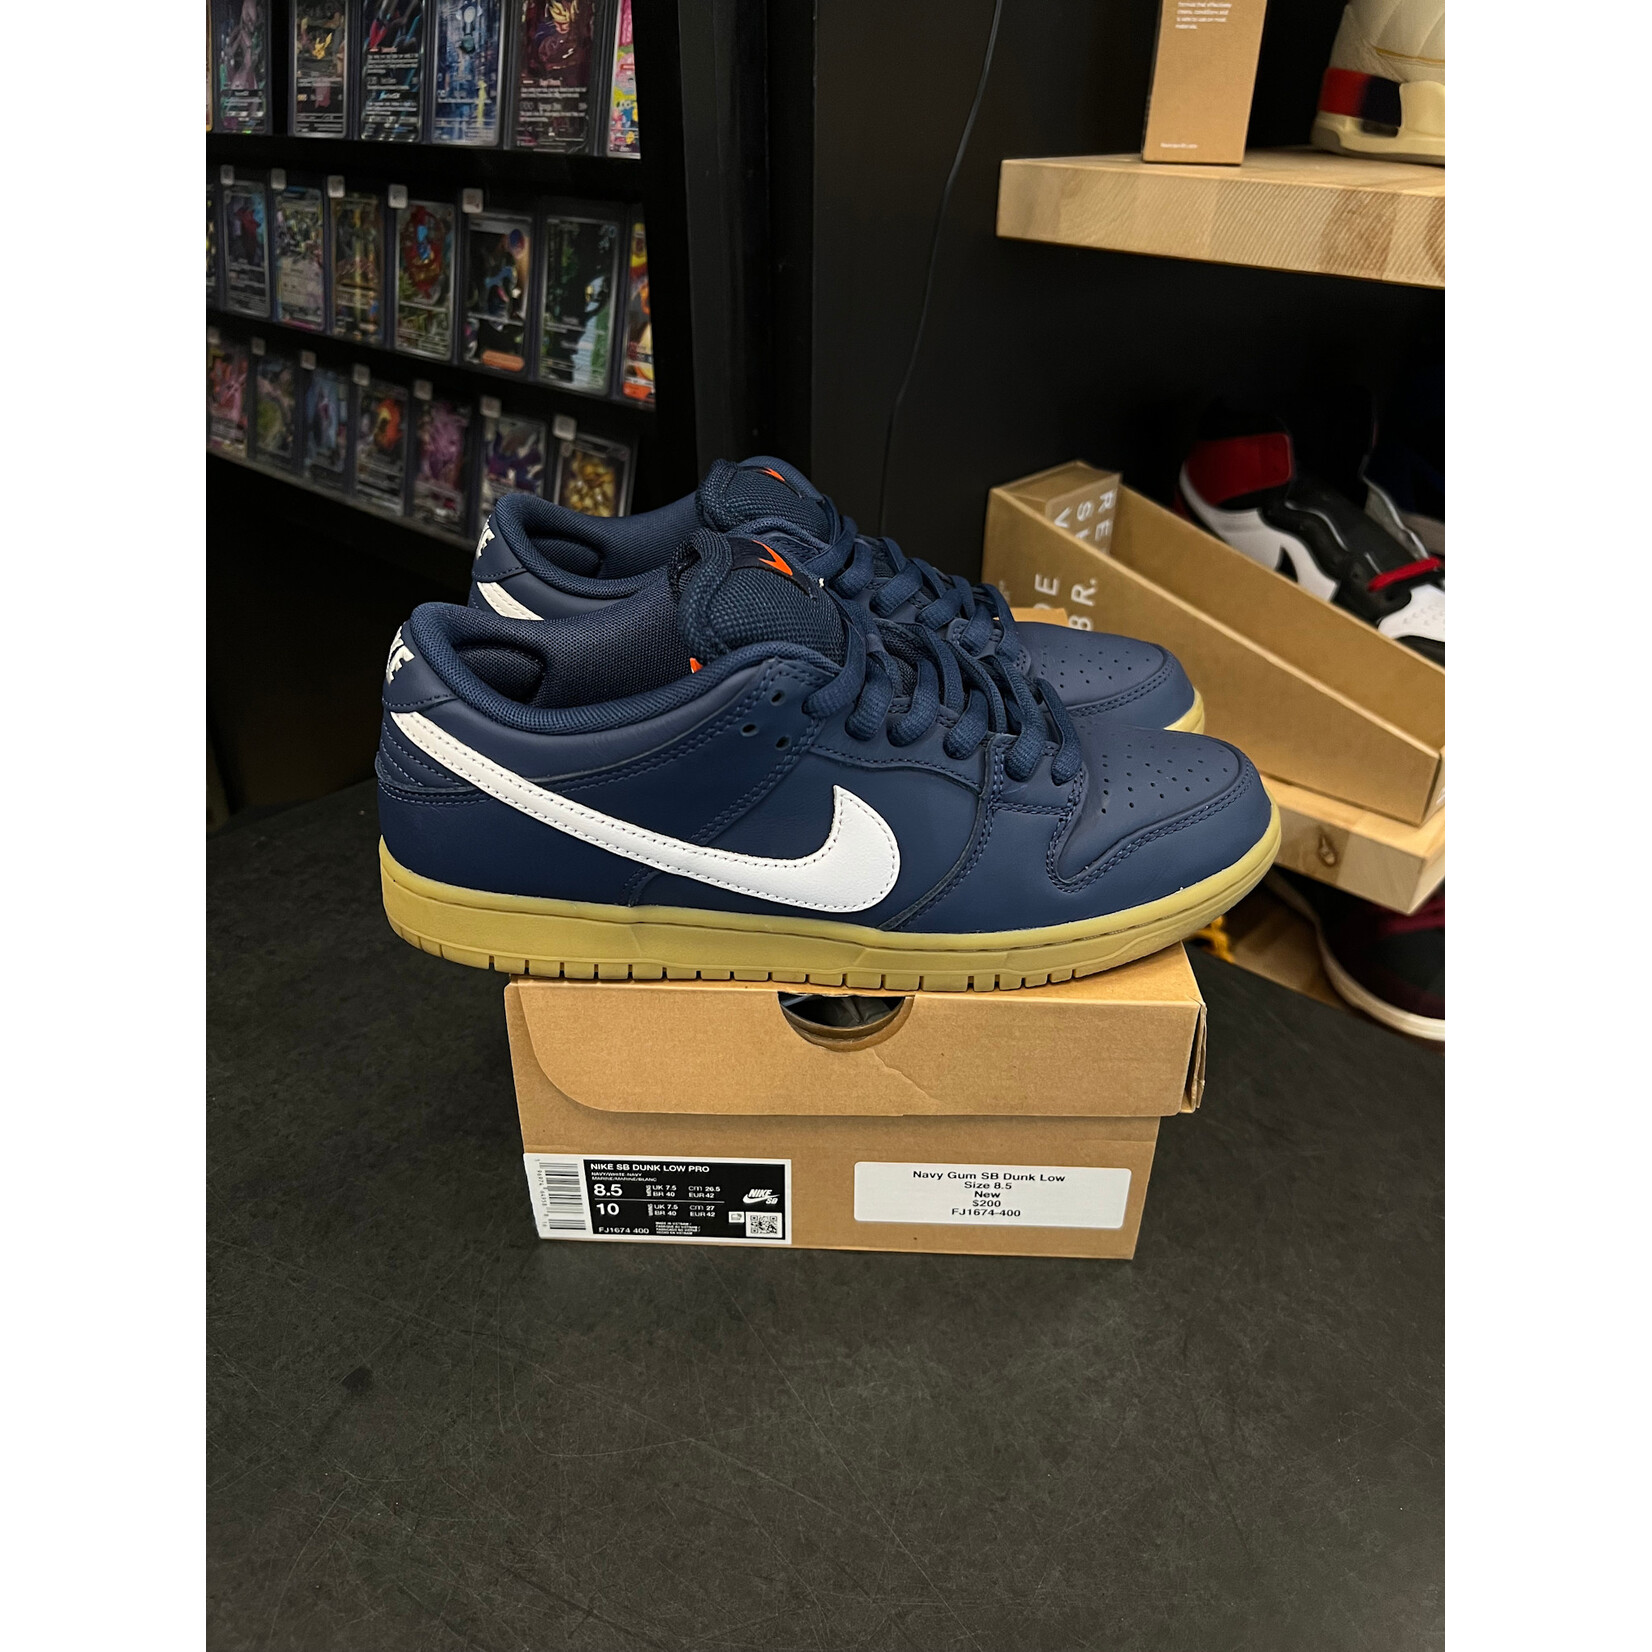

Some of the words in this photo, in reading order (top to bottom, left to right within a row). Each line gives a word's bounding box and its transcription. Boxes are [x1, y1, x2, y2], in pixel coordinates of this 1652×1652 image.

[590, 1163, 614, 1171] NIKE
[616, 1163, 630, 1171] SB
[663, 1164, 686, 1172] LOW
[688, 1165, 710, 1173] PRO
[912, 1170, 944, 1181] Navy
[947, 1171, 977, 1180] Gum
[981, 1172, 999, 1180] SB
[1003, 1172, 1036, 1181] Dunk
[1039, 1173, 1066, 1182] Low
[593, 1183, 623, 1197] 8.5
[964, 1181, 990, 1190] Size
[994, 1182, 1012, 1190] 8.5
[748, 1188, 773, 1198] NIKE
[974, 1190, 1001, 1198] New
[972, 1199, 1001, 1208] $200
[596, 1202, 620, 1216] 10
[951, 1208, 1021, 1217] FJ1674-400
[598, 1226, 631, 1234] FJ1674
